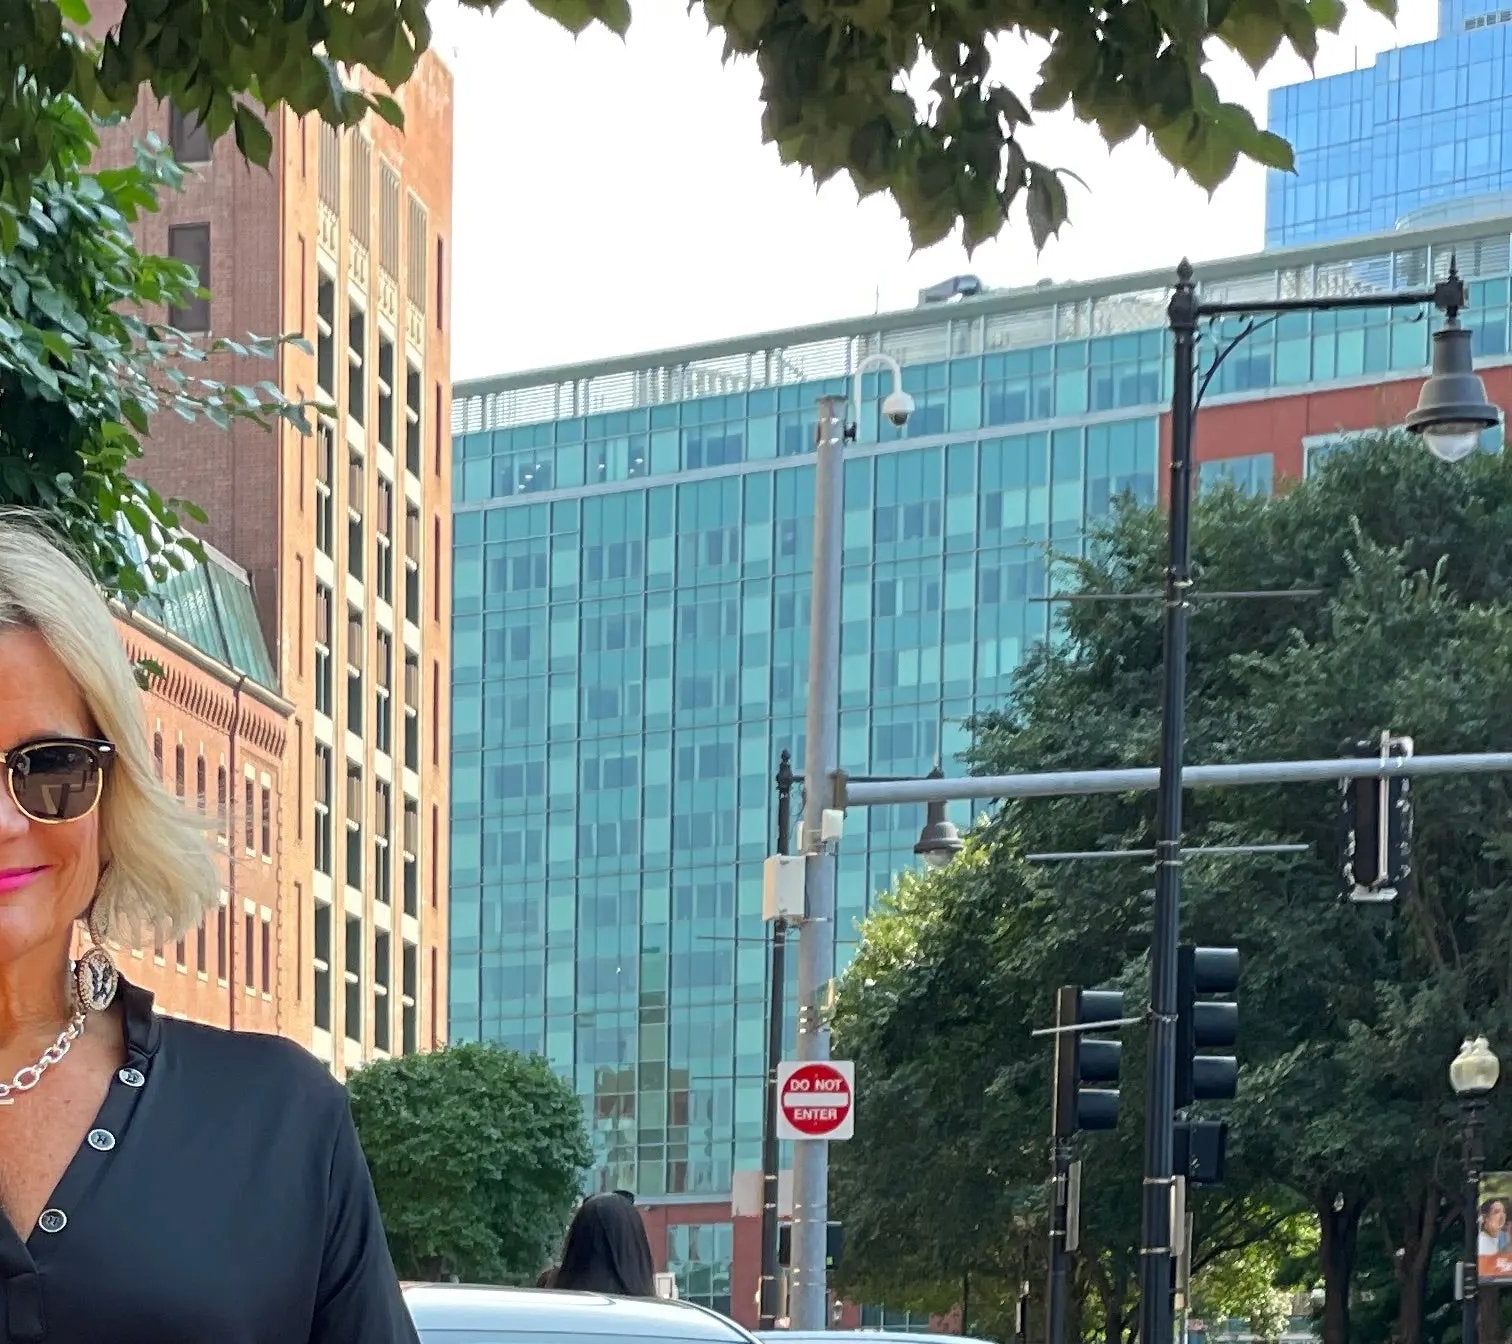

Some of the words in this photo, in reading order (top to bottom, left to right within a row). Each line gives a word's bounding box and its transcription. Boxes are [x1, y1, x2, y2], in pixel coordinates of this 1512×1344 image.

[790, 1079, 810, 1091] DO
[814, 1079, 843, 1091] NOT
[793, 1108, 838, 1120] ENTER
